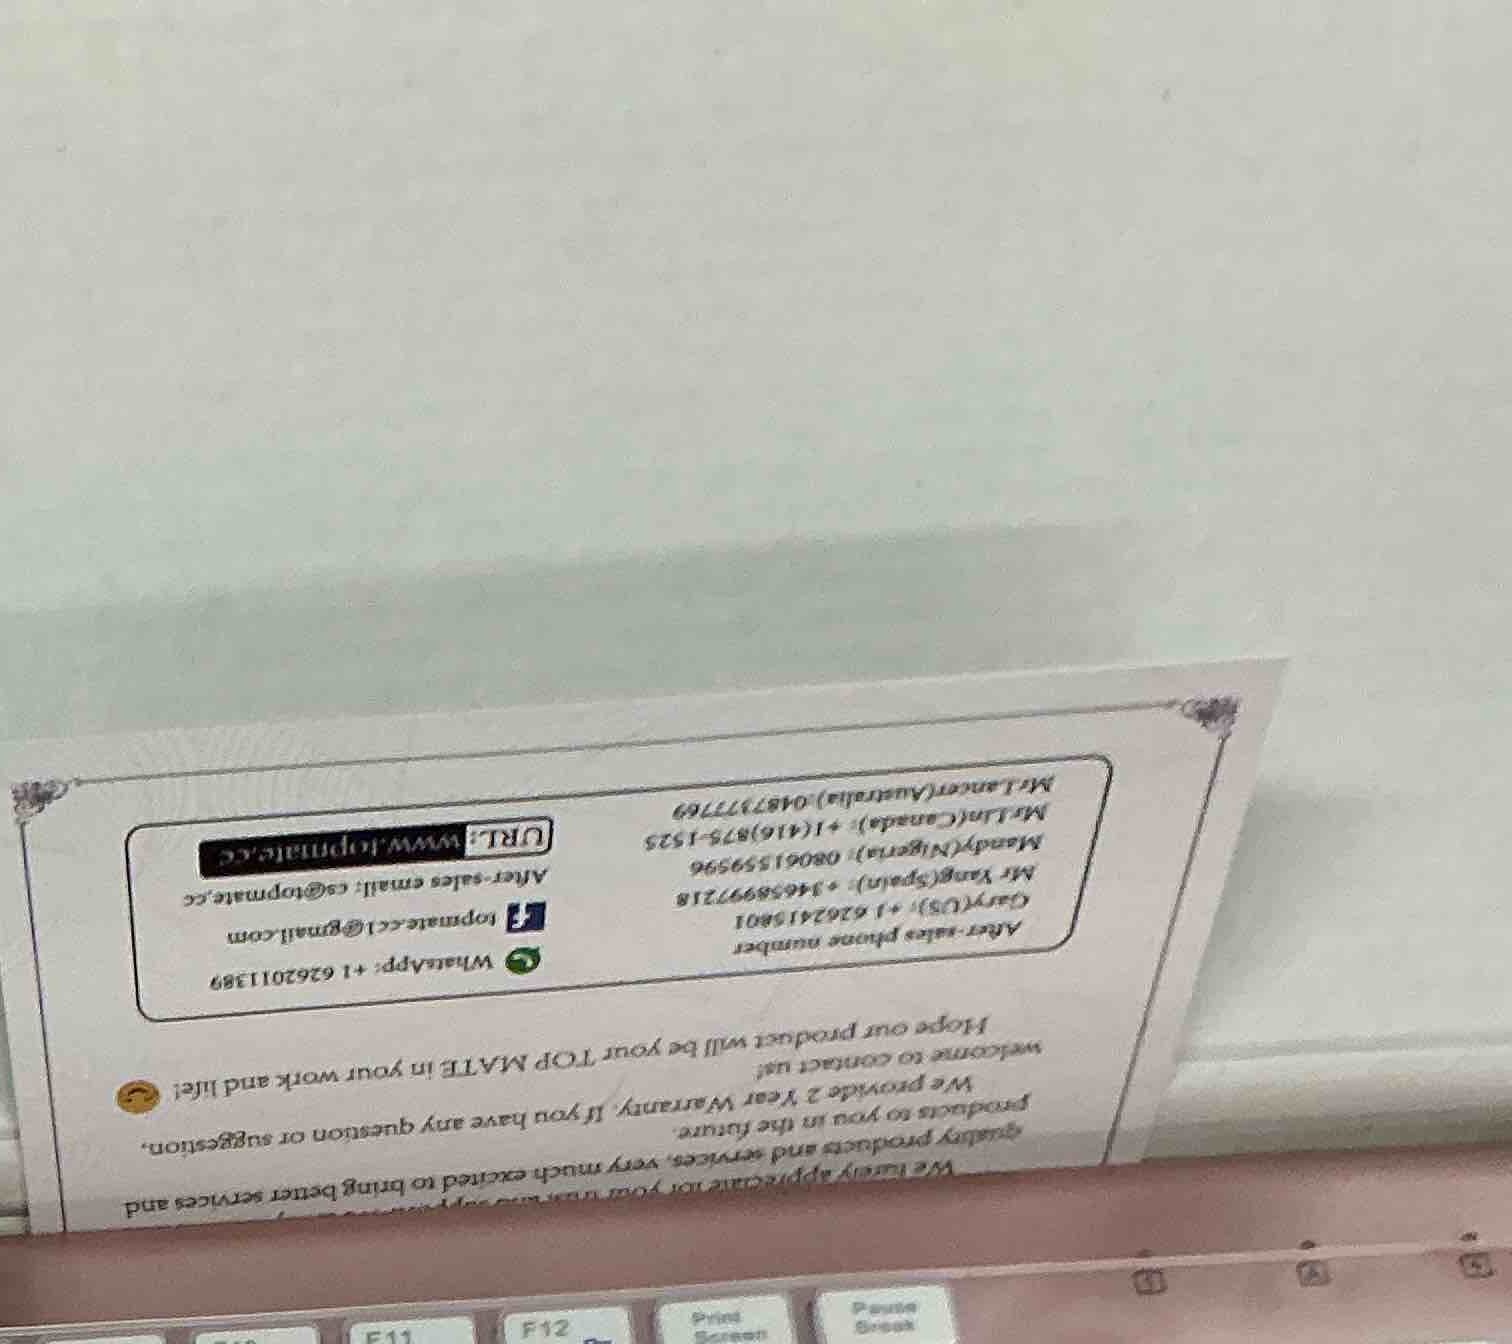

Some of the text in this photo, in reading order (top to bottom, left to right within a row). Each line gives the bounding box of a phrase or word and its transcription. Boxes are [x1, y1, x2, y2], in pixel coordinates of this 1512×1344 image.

[469, 825, 545, 850] URL:
[354, 875, 424, 896] email:
[429, 869, 548, 890] After-sales
[174, 1014, 989, 1101] Hope our product will be your TOP MATE in your work and life!
[828, 1074, 923, 1102] provide
[929, 1075, 973, 1093] We
[743, 1087, 797, 1109] Year
[807, 1087, 820, 1104] 2
[470, 1107, 527, 1128] have
[534, 1102, 580, 1124] you
[584, 1100, 604, 1124] If
[312, 1117, 415, 1143] question
[422, 1113, 465, 1134] any
[278, 1128, 305, 1143] or
[533, 1158, 602, 1184] much
[607, 1157, 659, 1178] very
[342, 1172, 406, 1196] bring
[410, 1176, 441, 1193] to
[447, 1167, 526, 1193] excited
[175, 1186, 265, 1213] services
[271, 1182, 338, 1202] better
[123, 1198, 170, 1219] and
[521, 1318, 570, 1339] F12
